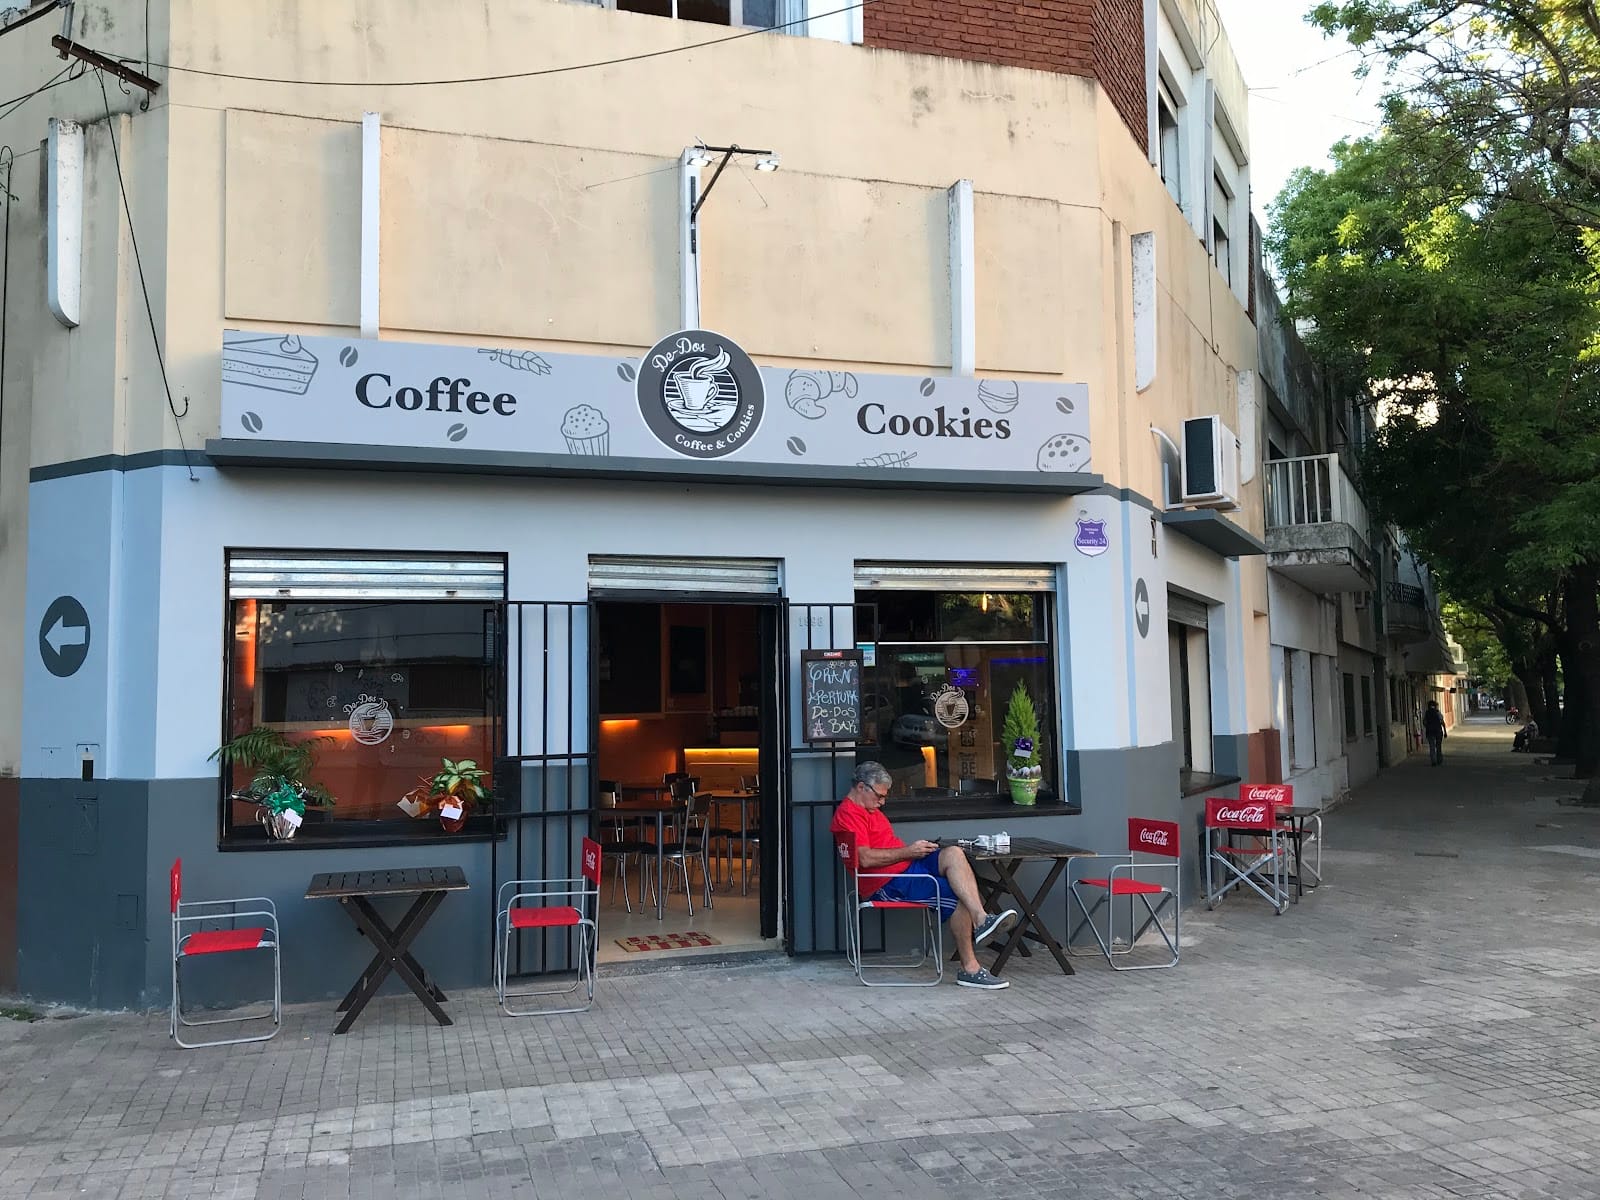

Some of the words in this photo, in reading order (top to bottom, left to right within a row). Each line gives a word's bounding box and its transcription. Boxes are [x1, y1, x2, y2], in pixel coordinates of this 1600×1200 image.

[652, 337, 705, 372] De-Dos
[355, 372, 517, 417] Coffee
[675, 433, 713, 451] Coffee
[716, 439, 726, 450] &
[726, 404, 755, 444] Cookies
[856, 402, 1011, 440] Cookies
[1077, 537, 1098, 546] Security
[343, 693, 376, 715] De-Dos
